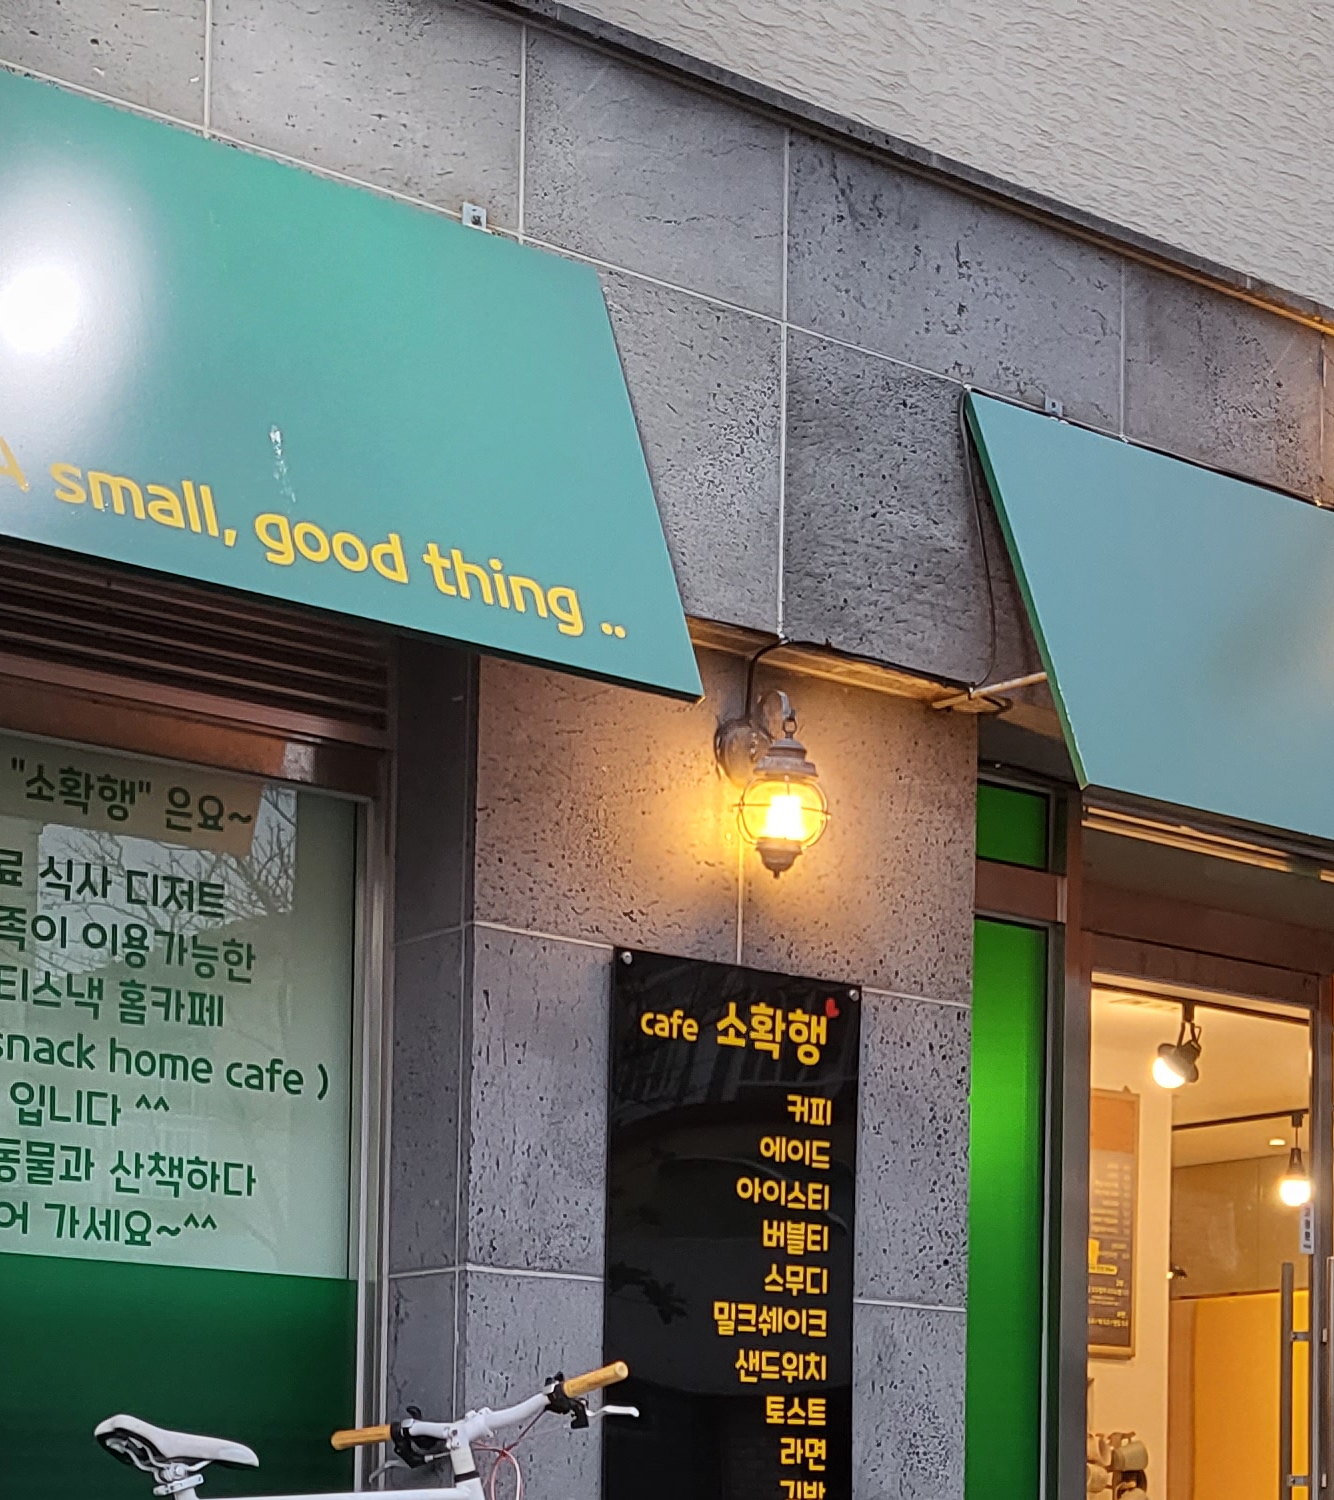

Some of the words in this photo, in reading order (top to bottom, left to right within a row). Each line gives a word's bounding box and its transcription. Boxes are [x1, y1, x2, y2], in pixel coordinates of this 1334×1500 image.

[50, 461, 238, 547] small,
[254, 512, 410, 585] good
[423, 542, 584, 637] thing
[11, 757, 152, 822] "소확행"
[164, 786, 254, 832] 은요~
[39, 856, 112, 901] 식사
[125, 868, 226, 919] 디저트
[81, 921, 257, 985] 이용가능한
[118, 979, 225, 1028] 홈카페
[640, 1009, 699, 1042] cafe
[716, 1002, 828, 1066] 소확행
[110, 1038, 213, 1083] home
[225, 1059, 305, 1096] cafe
[10, 1081, 121, 1127] 입니다
[786, 1094, 832, 1126] 커피
[759, 1136, 831, 1169] 에이드
[110, 1150, 257, 1198] 산책하다
[736, 1177, 830, 1211] 아이스티
[762, 1219, 829, 1256] 버블티
[764, 1263, 828, 1296] 스무디
[713, 1301, 828, 1337] 밀크쉐이크
[734, 1348, 827, 1383] 샌드위치
[765, 1396, 827, 1426] 토스트
[780, 1437, 827, 1471] 라면
